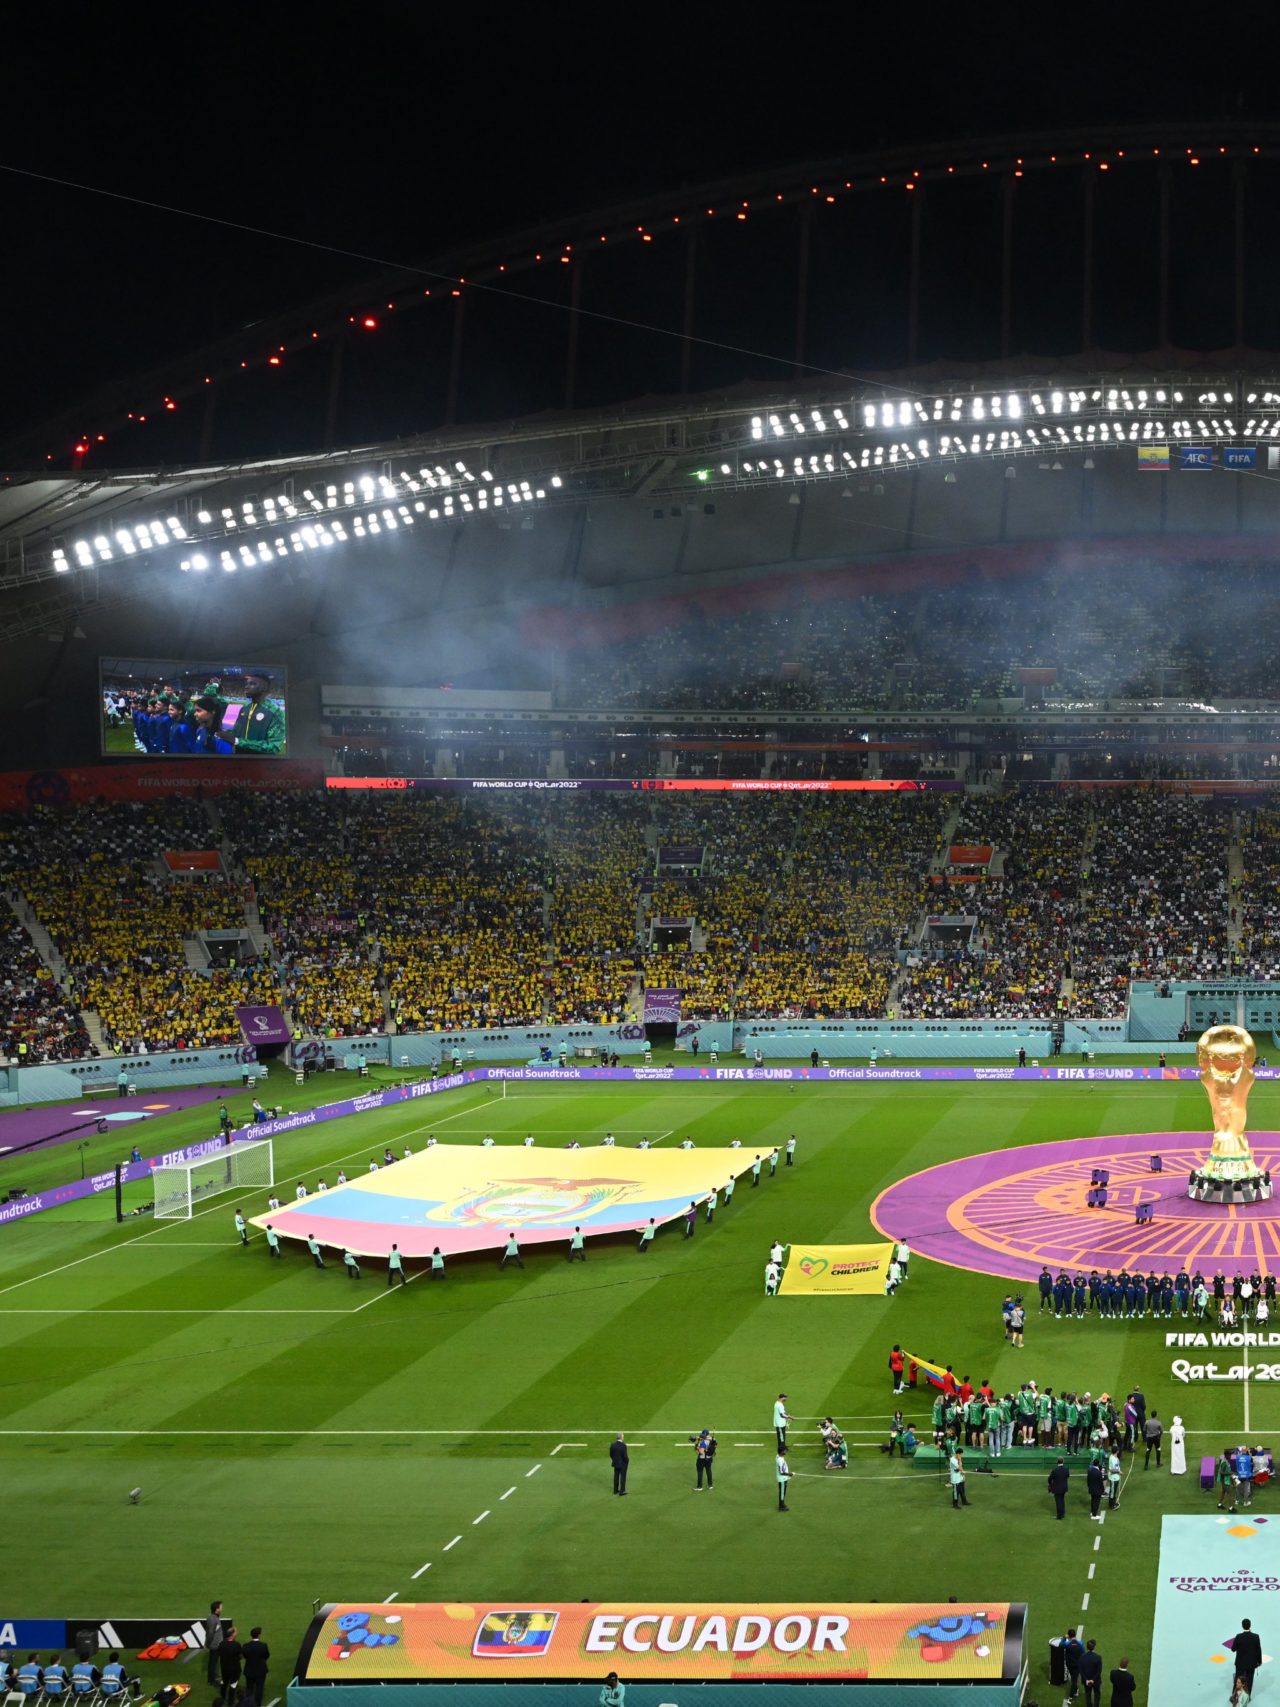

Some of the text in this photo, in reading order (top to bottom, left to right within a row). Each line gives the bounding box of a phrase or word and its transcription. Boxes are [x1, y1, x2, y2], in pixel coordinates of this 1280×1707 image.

[1229, 455, 1251, 463] FIFA
[488, 1070, 580, 1078] Official Soundtrack
[717, 1069, 744, 1078] FIFA
[829, 1070, 921, 1078] Official Soundtrack
[1058, 1069, 1085, 1078] FIFA
[412, 1083, 431, 1096] FIFA
[247, 1112, 316, 1139] Official Soundtrack
[162, 1150, 184, 1166] FIFA
[832, 1260, 880, 1269] PROTECT
[831, 1265, 879, 1275] CHILDREN
[1165, 1333, 1208, 1347] FIFA
[586, 1614, 851, 1652] ECUADOR
